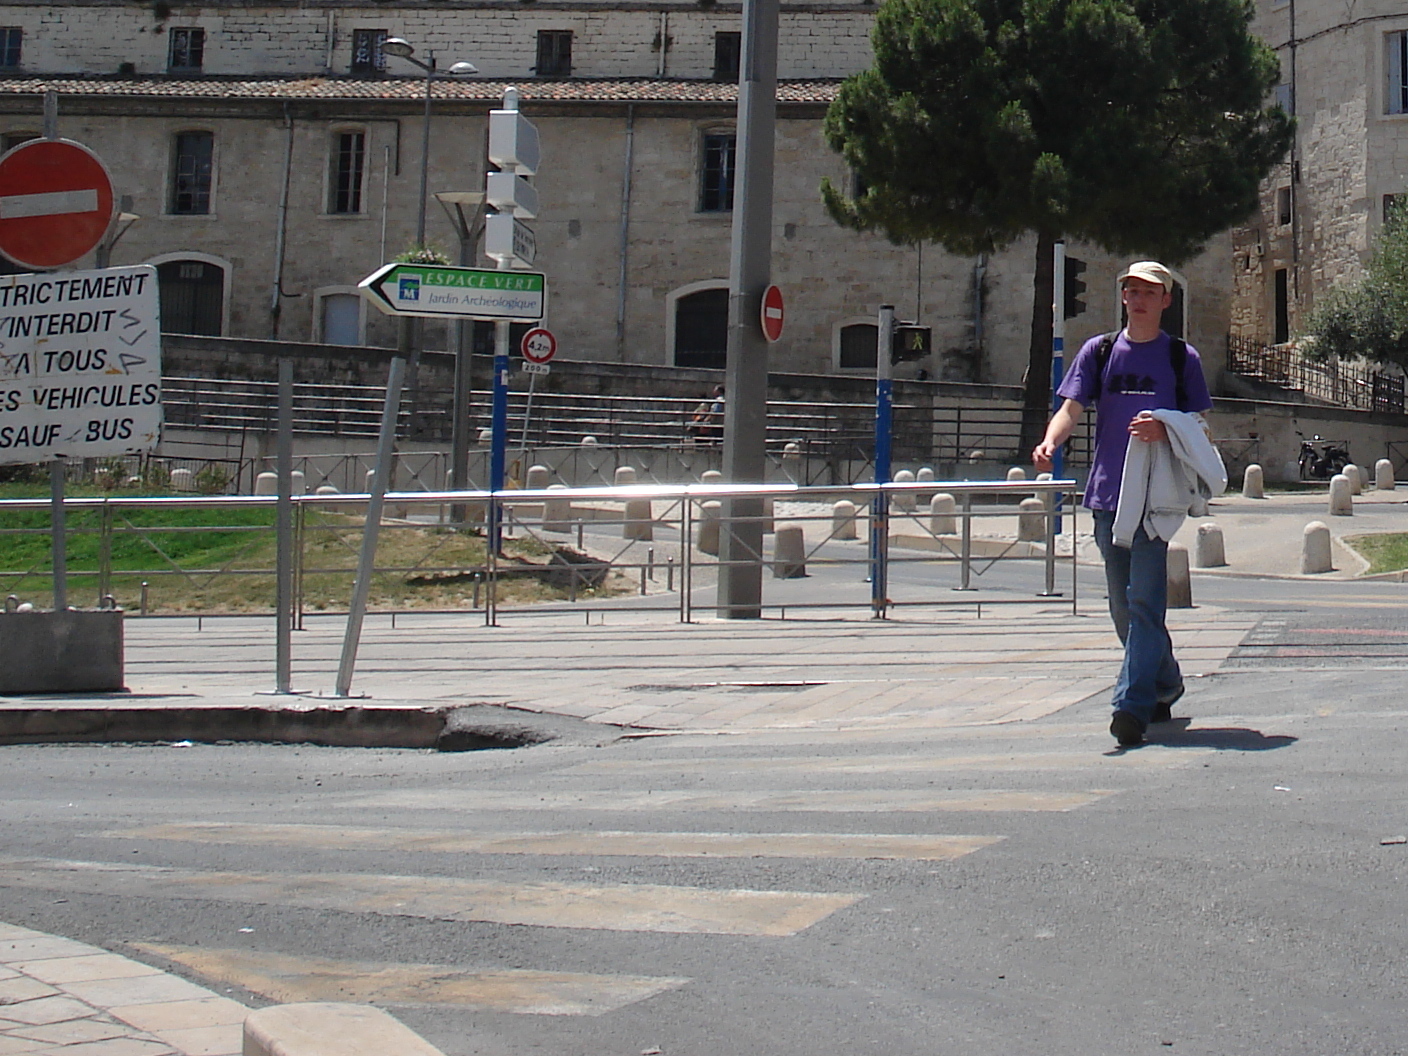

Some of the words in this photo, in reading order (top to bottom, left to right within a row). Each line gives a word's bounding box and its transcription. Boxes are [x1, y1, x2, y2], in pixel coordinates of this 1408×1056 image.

[426, 272, 487, 288] ESPACE
[494, 277, 534, 290] VERT
[429, 292, 459, 304] Jardin
[8, 310, 116, 338] INTERDIT
[43, 349, 107, 374] TOUS
[33, 383, 158, 411] VEHICULES
[0, 424, 62, 448] SAUF
[85, 418, 134, 442] BUS
